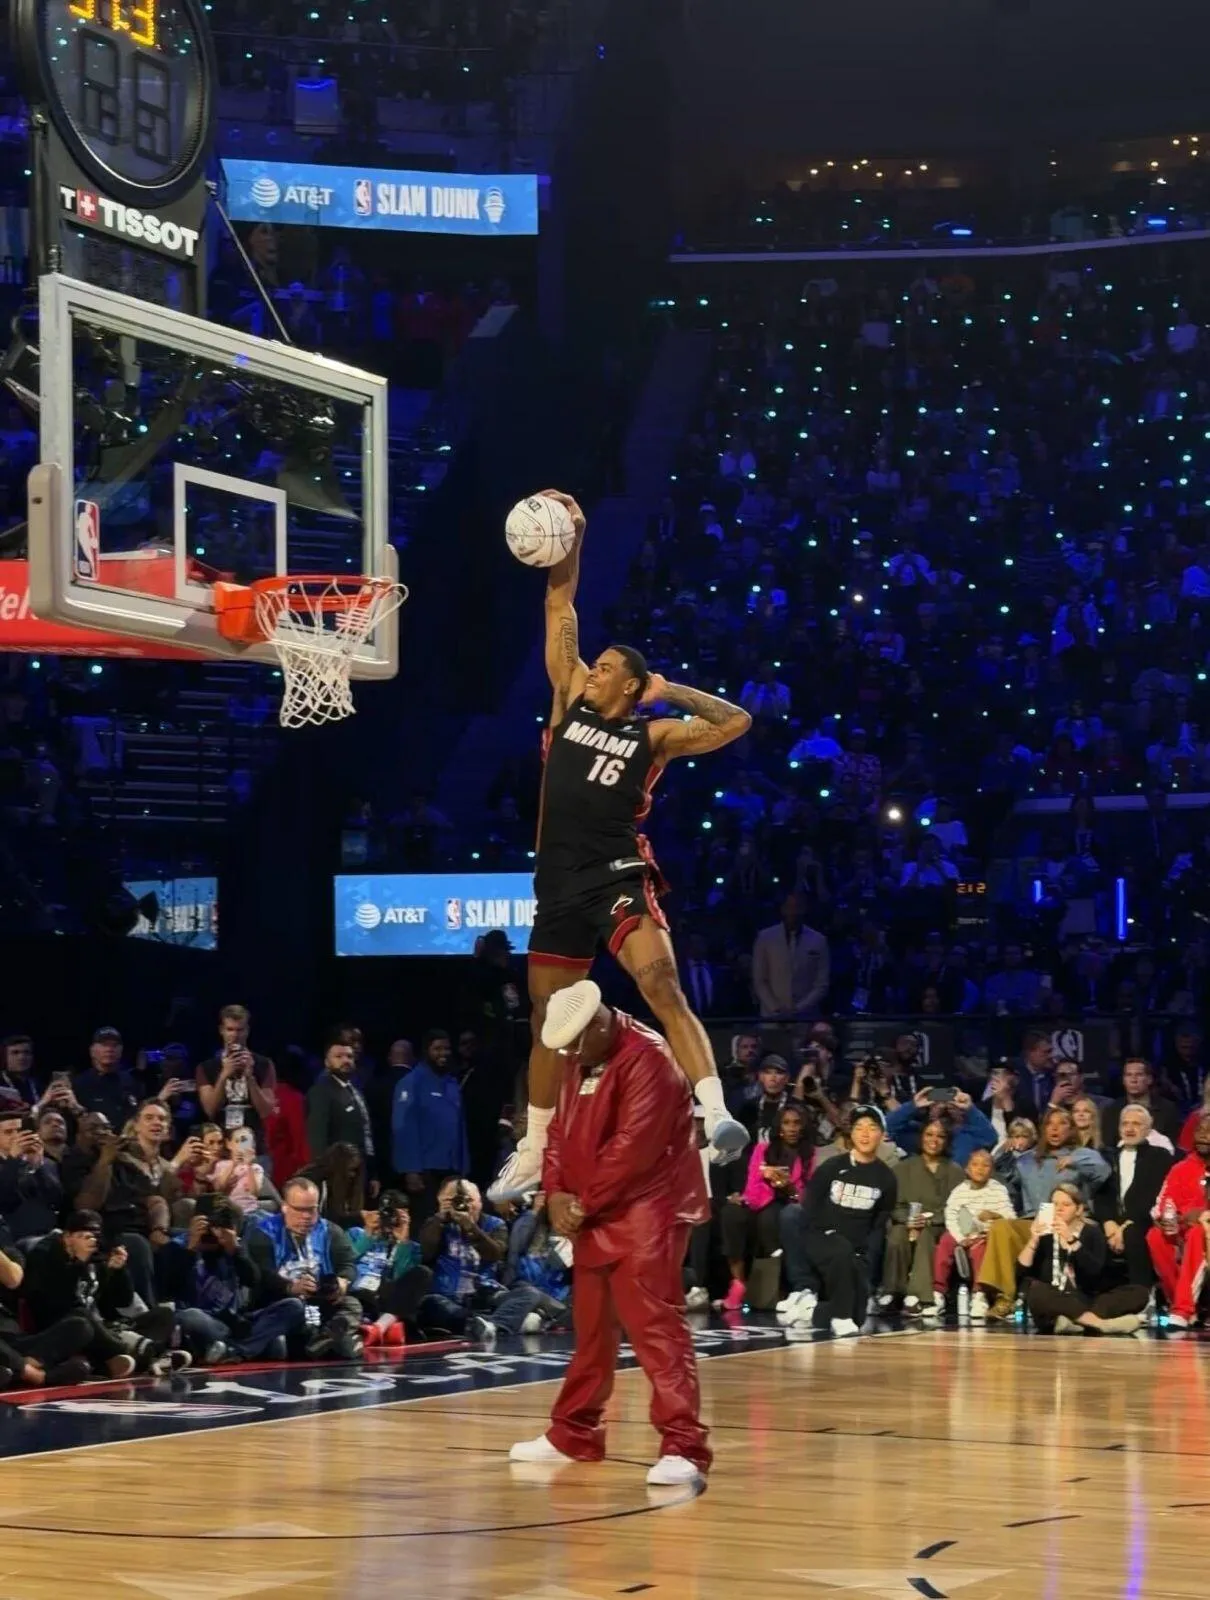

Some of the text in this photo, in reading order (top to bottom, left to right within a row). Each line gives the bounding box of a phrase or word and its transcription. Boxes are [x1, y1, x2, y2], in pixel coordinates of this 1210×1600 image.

[283, 185, 335, 210] AT&T
[377, 183, 480, 219] SLAM DUNK
[98, 197, 199, 257] TISSOT
[563, 721, 639, 759] MIAMI
[587, 754, 626, 786] 16
[383, 906, 429, 924] AT&T
[465, 899, 538, 927] SLAM DU
